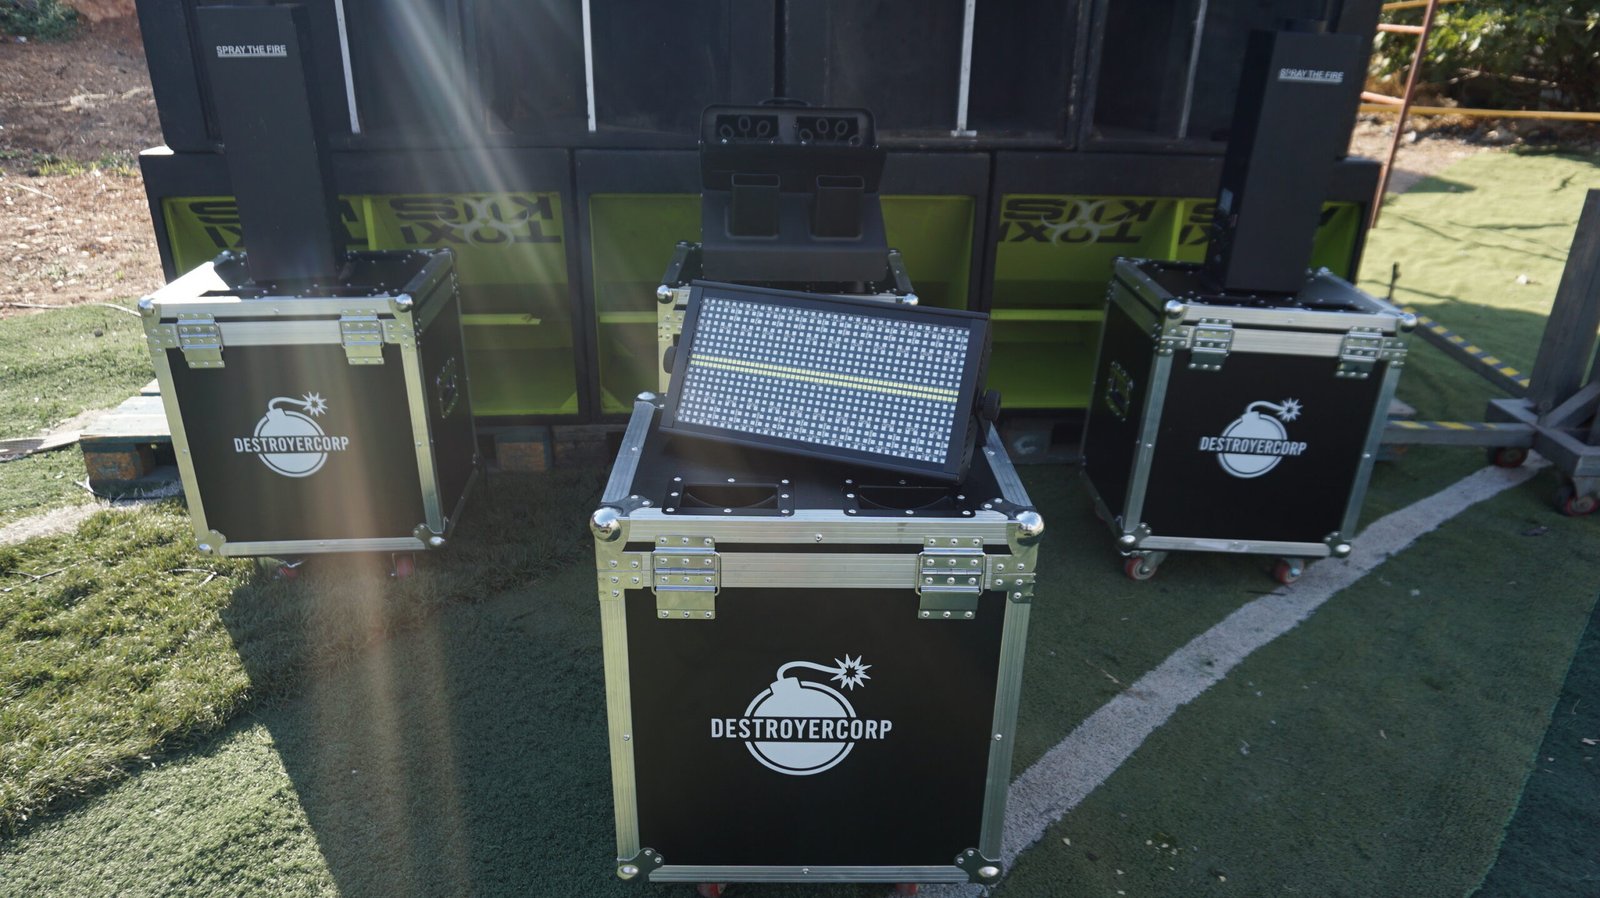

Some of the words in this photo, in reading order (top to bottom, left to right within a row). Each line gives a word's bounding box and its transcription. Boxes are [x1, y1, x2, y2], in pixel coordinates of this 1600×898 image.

[216, 45, 245, 56] SPRAY
[247, 45, 265, 56] THE
[266, 45, 286, 56] FIRE
[1279, 68, 1307, 79] SPRAY
[1308, 69, 1324, 81] THE
[1325, 71, 1344, 82] FIRE
[234, 436, 349, 452] DESTROYERCORP
[1200, 436, 1307, 455] DESTROYERCORP
[711, 718, 892, 740] DESTROYERCORP
